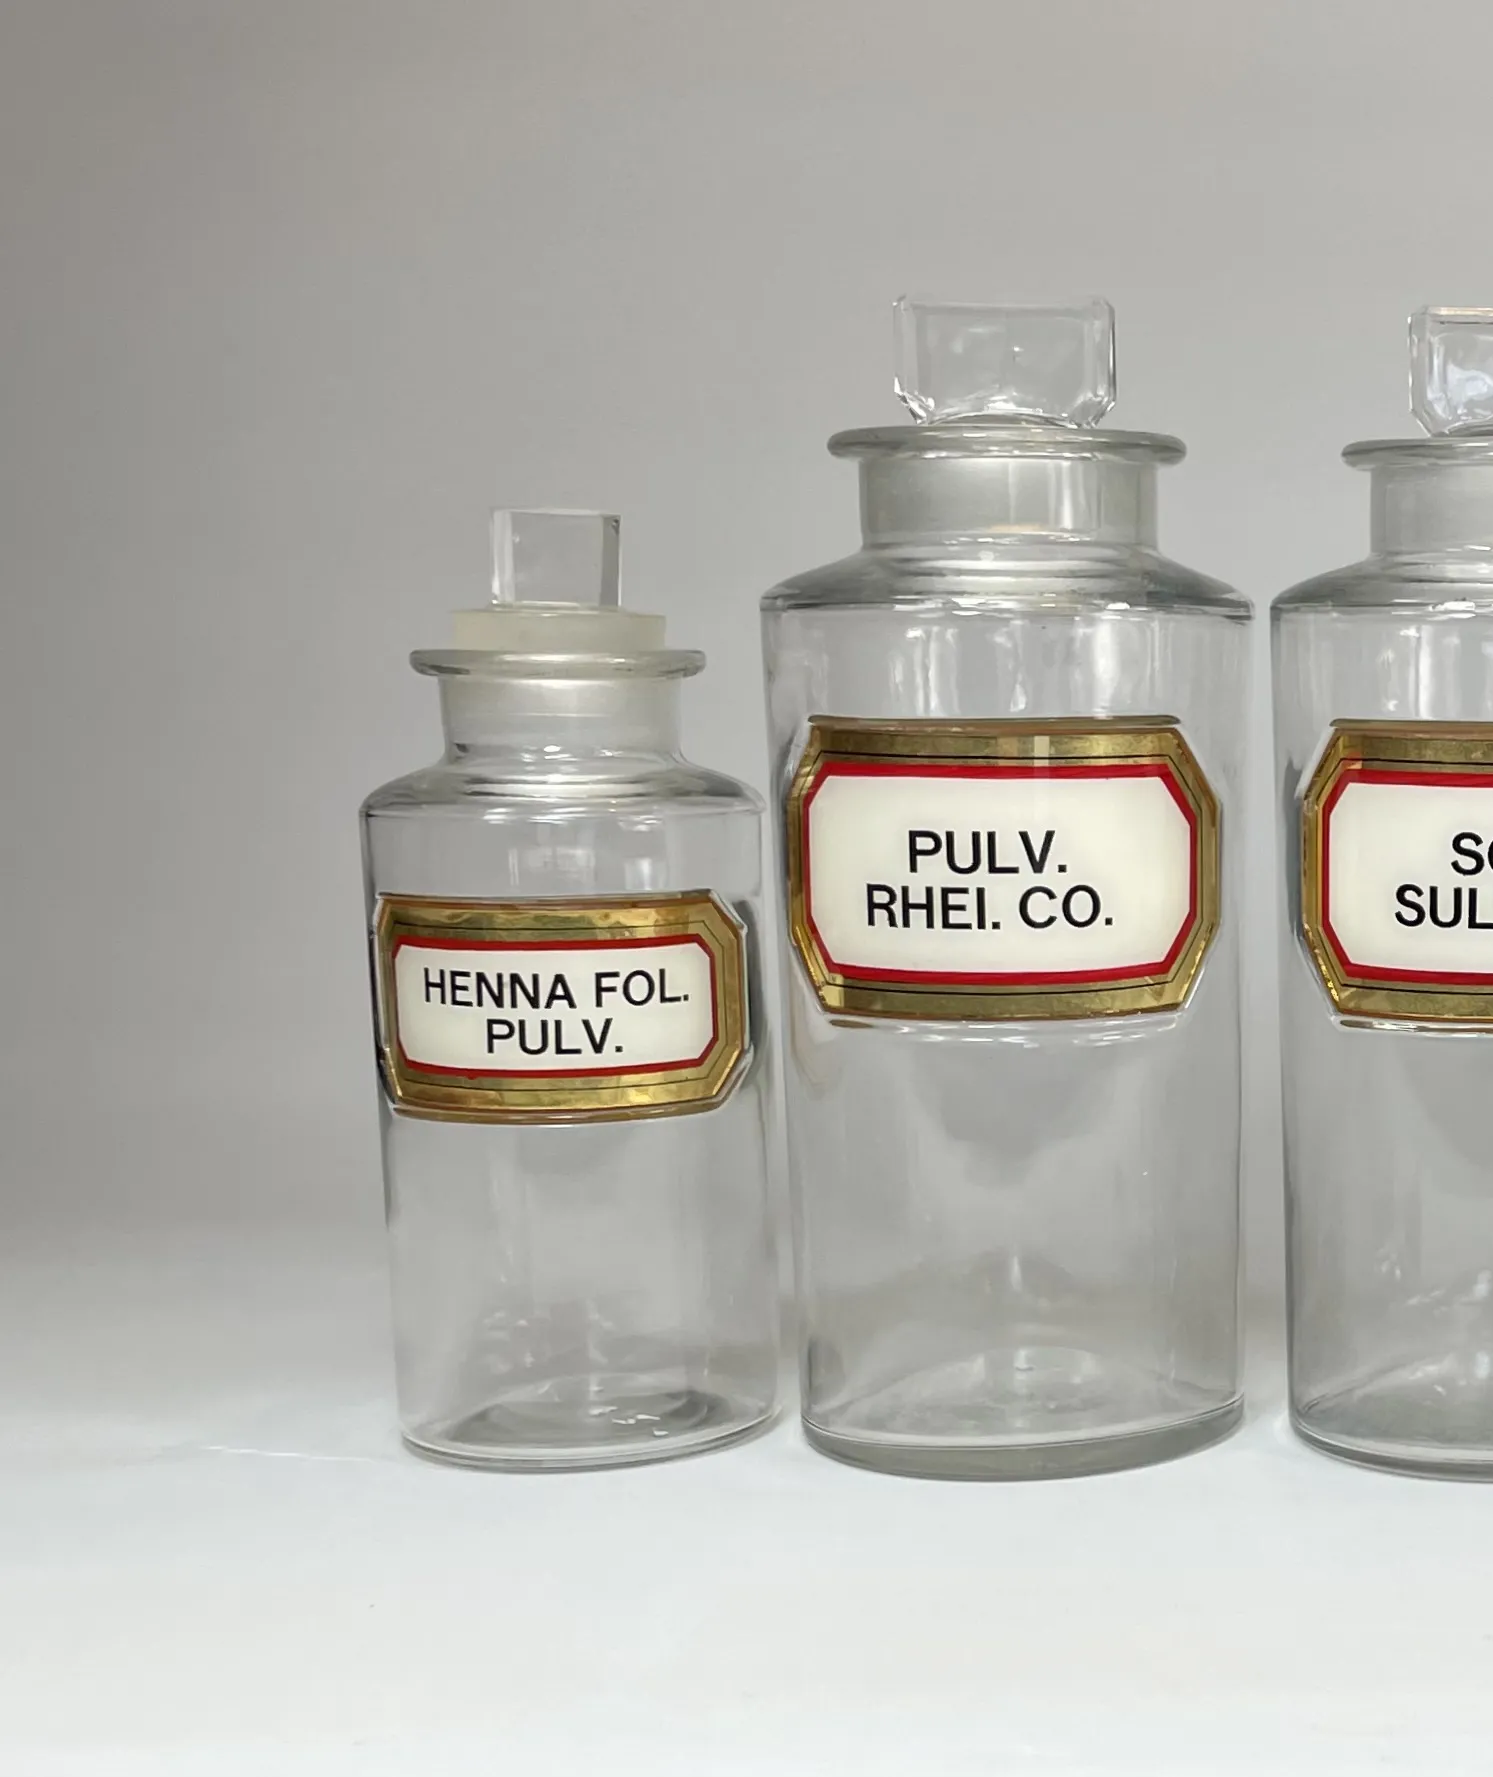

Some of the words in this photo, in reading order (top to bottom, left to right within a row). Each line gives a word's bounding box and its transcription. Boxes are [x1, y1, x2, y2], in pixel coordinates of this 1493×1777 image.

[908, 830, 1067, 875] PULV.
[866, 883, 1001, 931] RHEI.
[1019, 884, 1113, 929] CO.
[422, 967, 577, 1010] HENNA
[594, 968, 690, 1008] FOL.
[486, 1018, 623, 1055] PULV.
